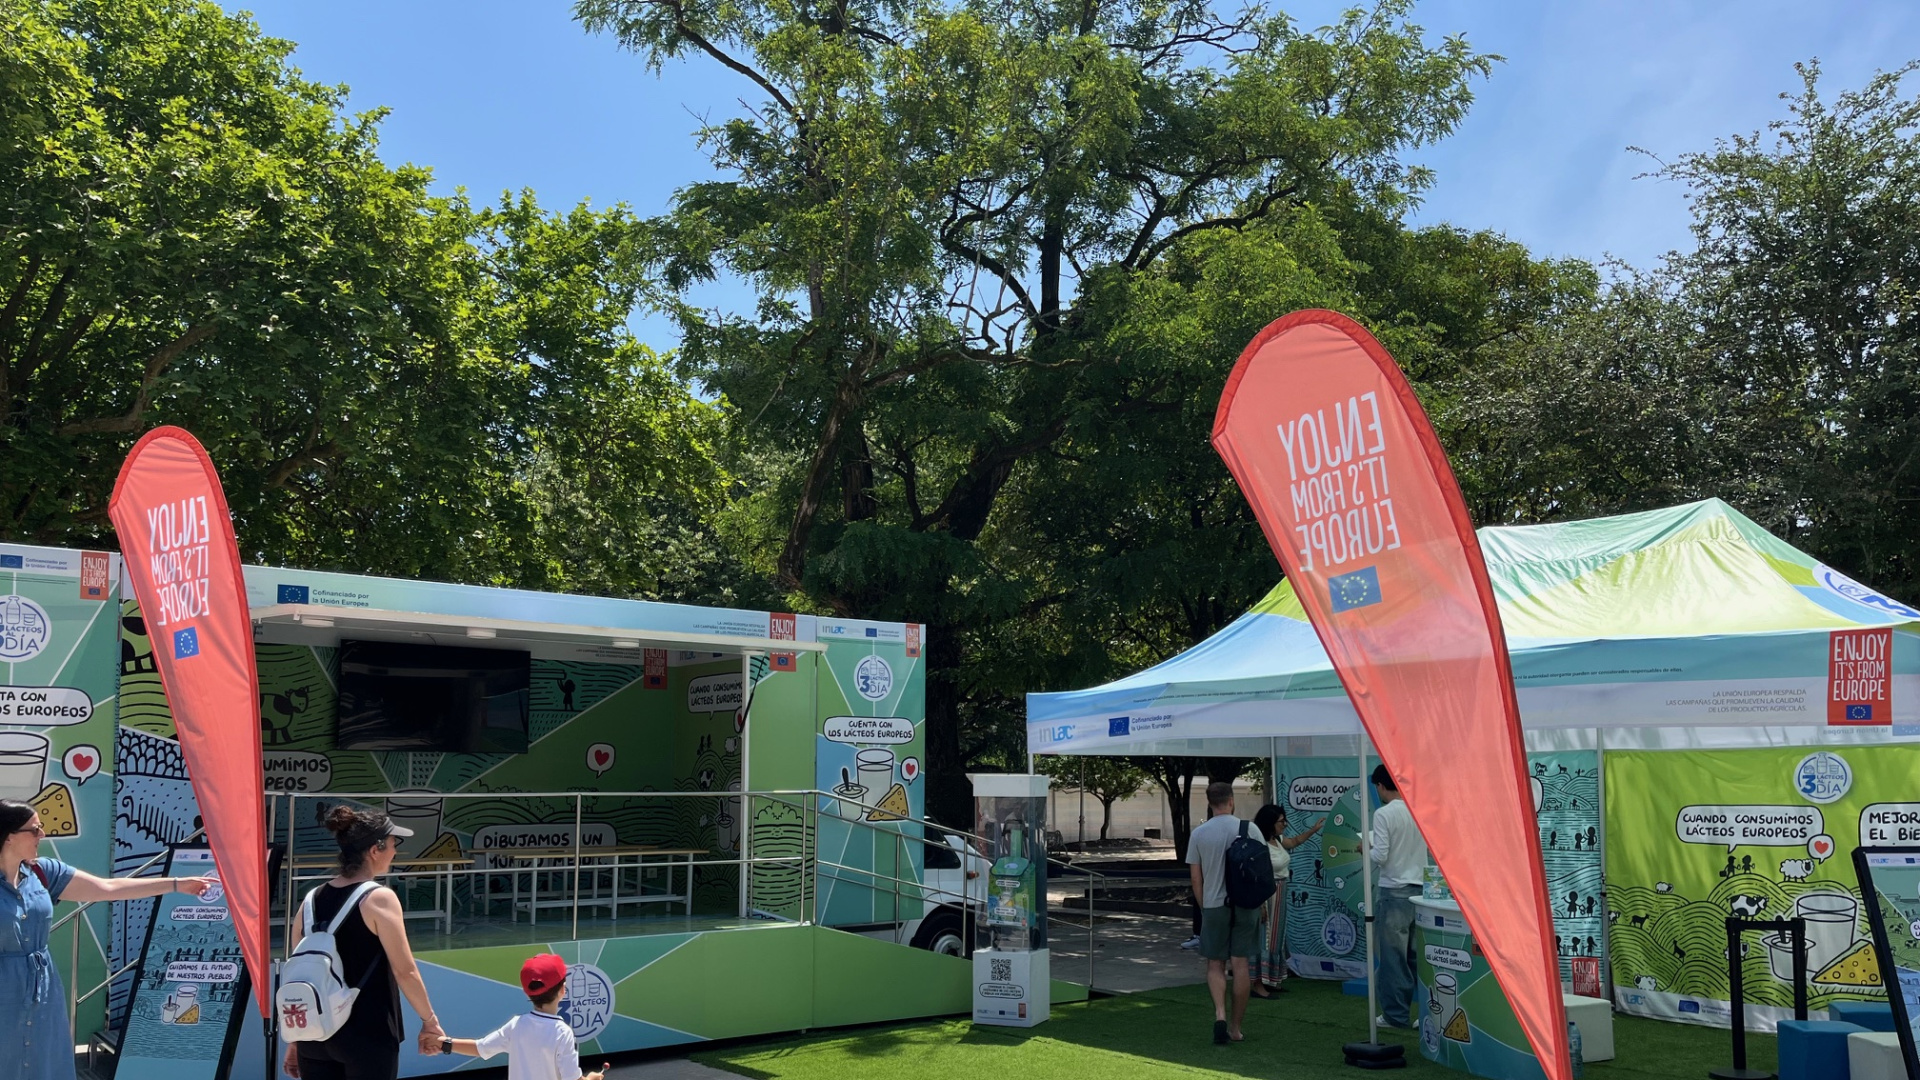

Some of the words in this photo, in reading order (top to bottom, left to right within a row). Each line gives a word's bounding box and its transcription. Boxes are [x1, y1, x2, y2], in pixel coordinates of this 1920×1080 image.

[83, 557, 108, 569] ENJOY
[83, 576, 106, 588] EUROPE
[312, 589, 356, 598] Cofinanciado
[320, 597, 340, 605] Unión
[341, 599, 370, 607] Europea
[5, 623, 42, 633] LÁCTEOS
[771, 618, 794, 634] ENJOY
[5, 634, 39, 651] DÍA
[1834, 633, 1888, 662] ENJOY
[1835, 661, 1855, 680] IT'S
[1857, 660, 1885, 679] FROM
[690, 684, 710, 695] CUANDO
[859, 675, 870, 693] 3
[870, 682, 888, 693] DÍA
[1833, 679, 1885, 701] EUROPE
[21, 692, 47, 702] CON
[691, 695, 714, 706] LÁCTEOS
[1678, 698, 1711, 706] CAMPAÑAS
[17, 705, 87, 718] EUROPEOS
[849, 720, 877, 728] CUENTA
[1131, 714, 1162, 724] Cofinanciado
[1163, 714, 1172, 722] por
[1151, 722, 1173, 730] Europea
[844, 728, 875, 737] LÁCTEOS
[877, 730, 913, 739] EUROPEOS
[1293, 784, 1328, 794] CUANDO
[1801, 774, 1816, 794] 3
[1817, 781, 1842, 794] DÍA
[1296, 794, 1334, 806] LÁCTEOS
[1683, 813, 1727, 824] CUANDO
[1686, 824, 1735, 837] LÁCTEOS
[1742, 827, 1808, 839] EUROPEOS
[1869, 828, 1888, 841] EL
[582, 832, 603, 846] UN
[1326, 930, 1336, 946] 3
[1433, 948, 1450, 956] CUENTA
[1449, 958, 1471, 969] EUROPEOS
[1573, 961, 1596, 974] ENJOY
[557, 1000, 571, 1025] 3
[572, 997, 607, 1008] LÁCTEOS
[572, 1009, 605, 1029] DÍA
